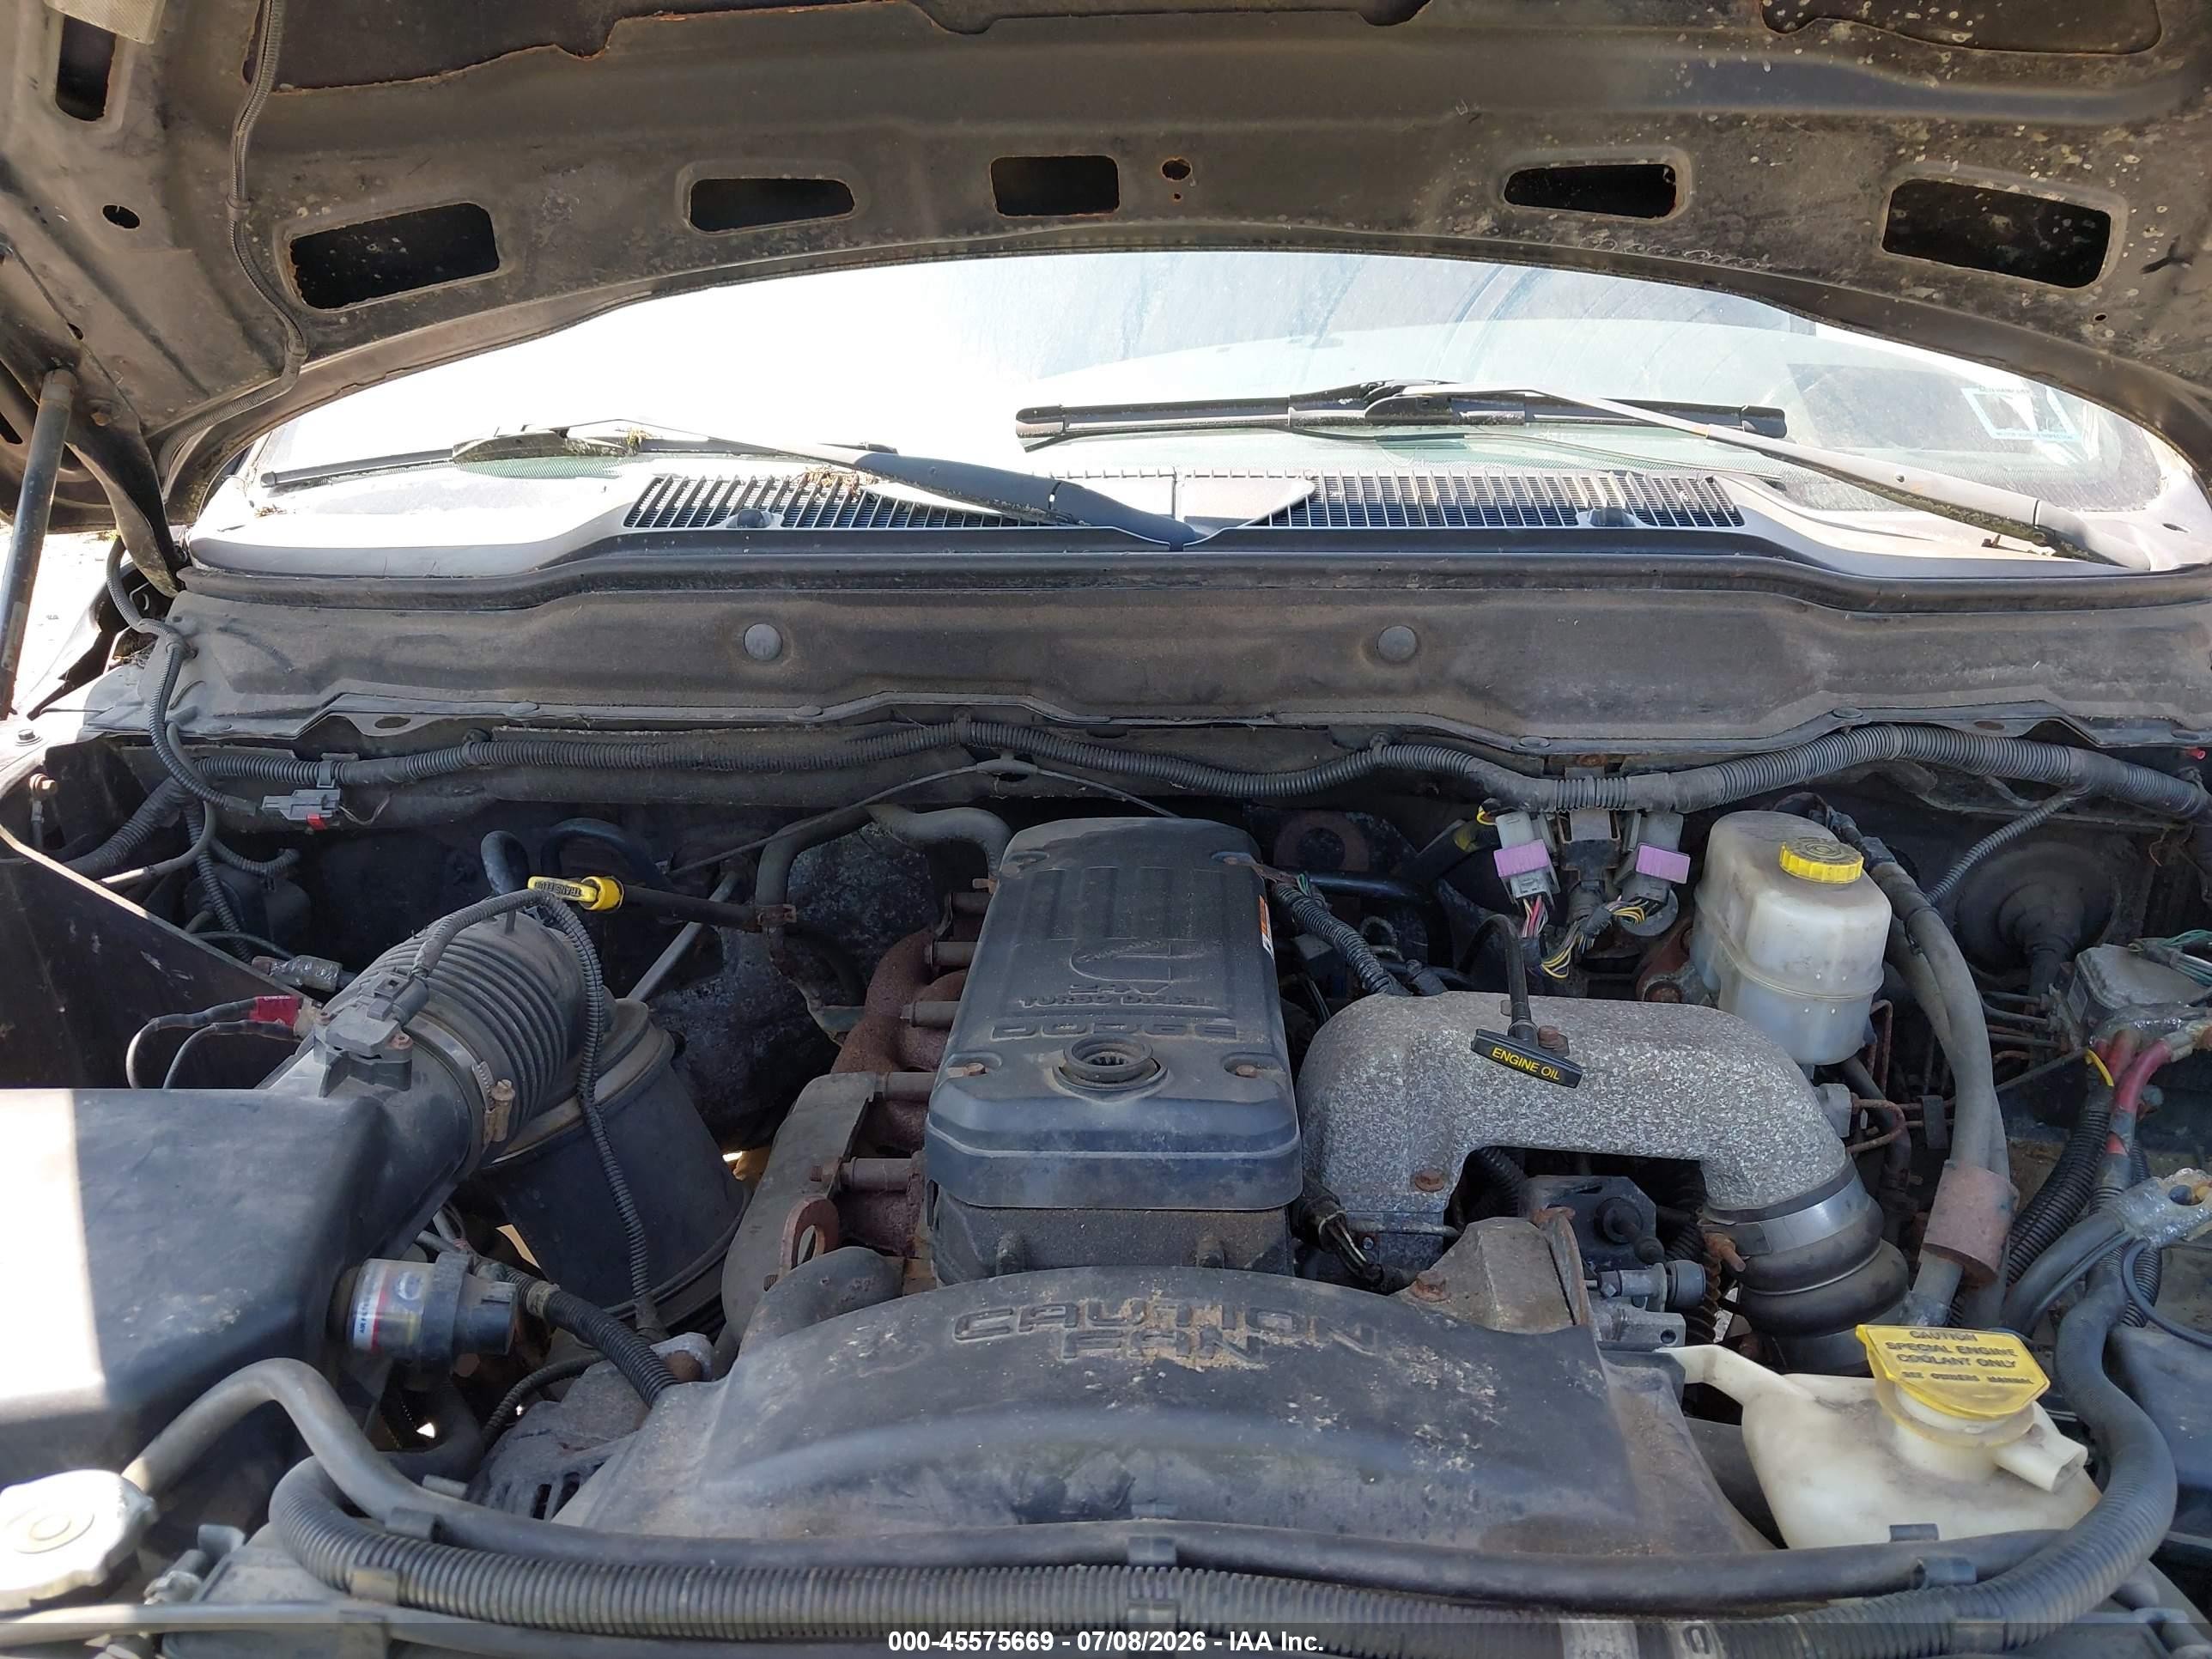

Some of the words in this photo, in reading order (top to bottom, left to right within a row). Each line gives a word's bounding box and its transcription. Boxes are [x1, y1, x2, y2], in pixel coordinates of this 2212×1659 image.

[560, 884, 580, 896] TRANS
[1019, 995, 1114, 1008] TURBO
[1120, 995, 1217, 1009] DIESEL
[990, 1022, 1237, 1042] DODGE
[1492, 1047, 1540, 1073] ENGINE
[1540, 1066, 1560, 1080] OIL
[952, 1297, 1381, 1356] CAUTION
[1910, 1330, 1978, 1341] CAUTION
[1060, 1327, 1266, 1364] FAN
[1886, 1341, 1954, 1354] SPECIAL
[1956, 1346, 2018, 1357] ENGINE
[1896, 1353, 1972, 1366] COOLANT
[1977, 1358, 2018, 1369] ONLY
